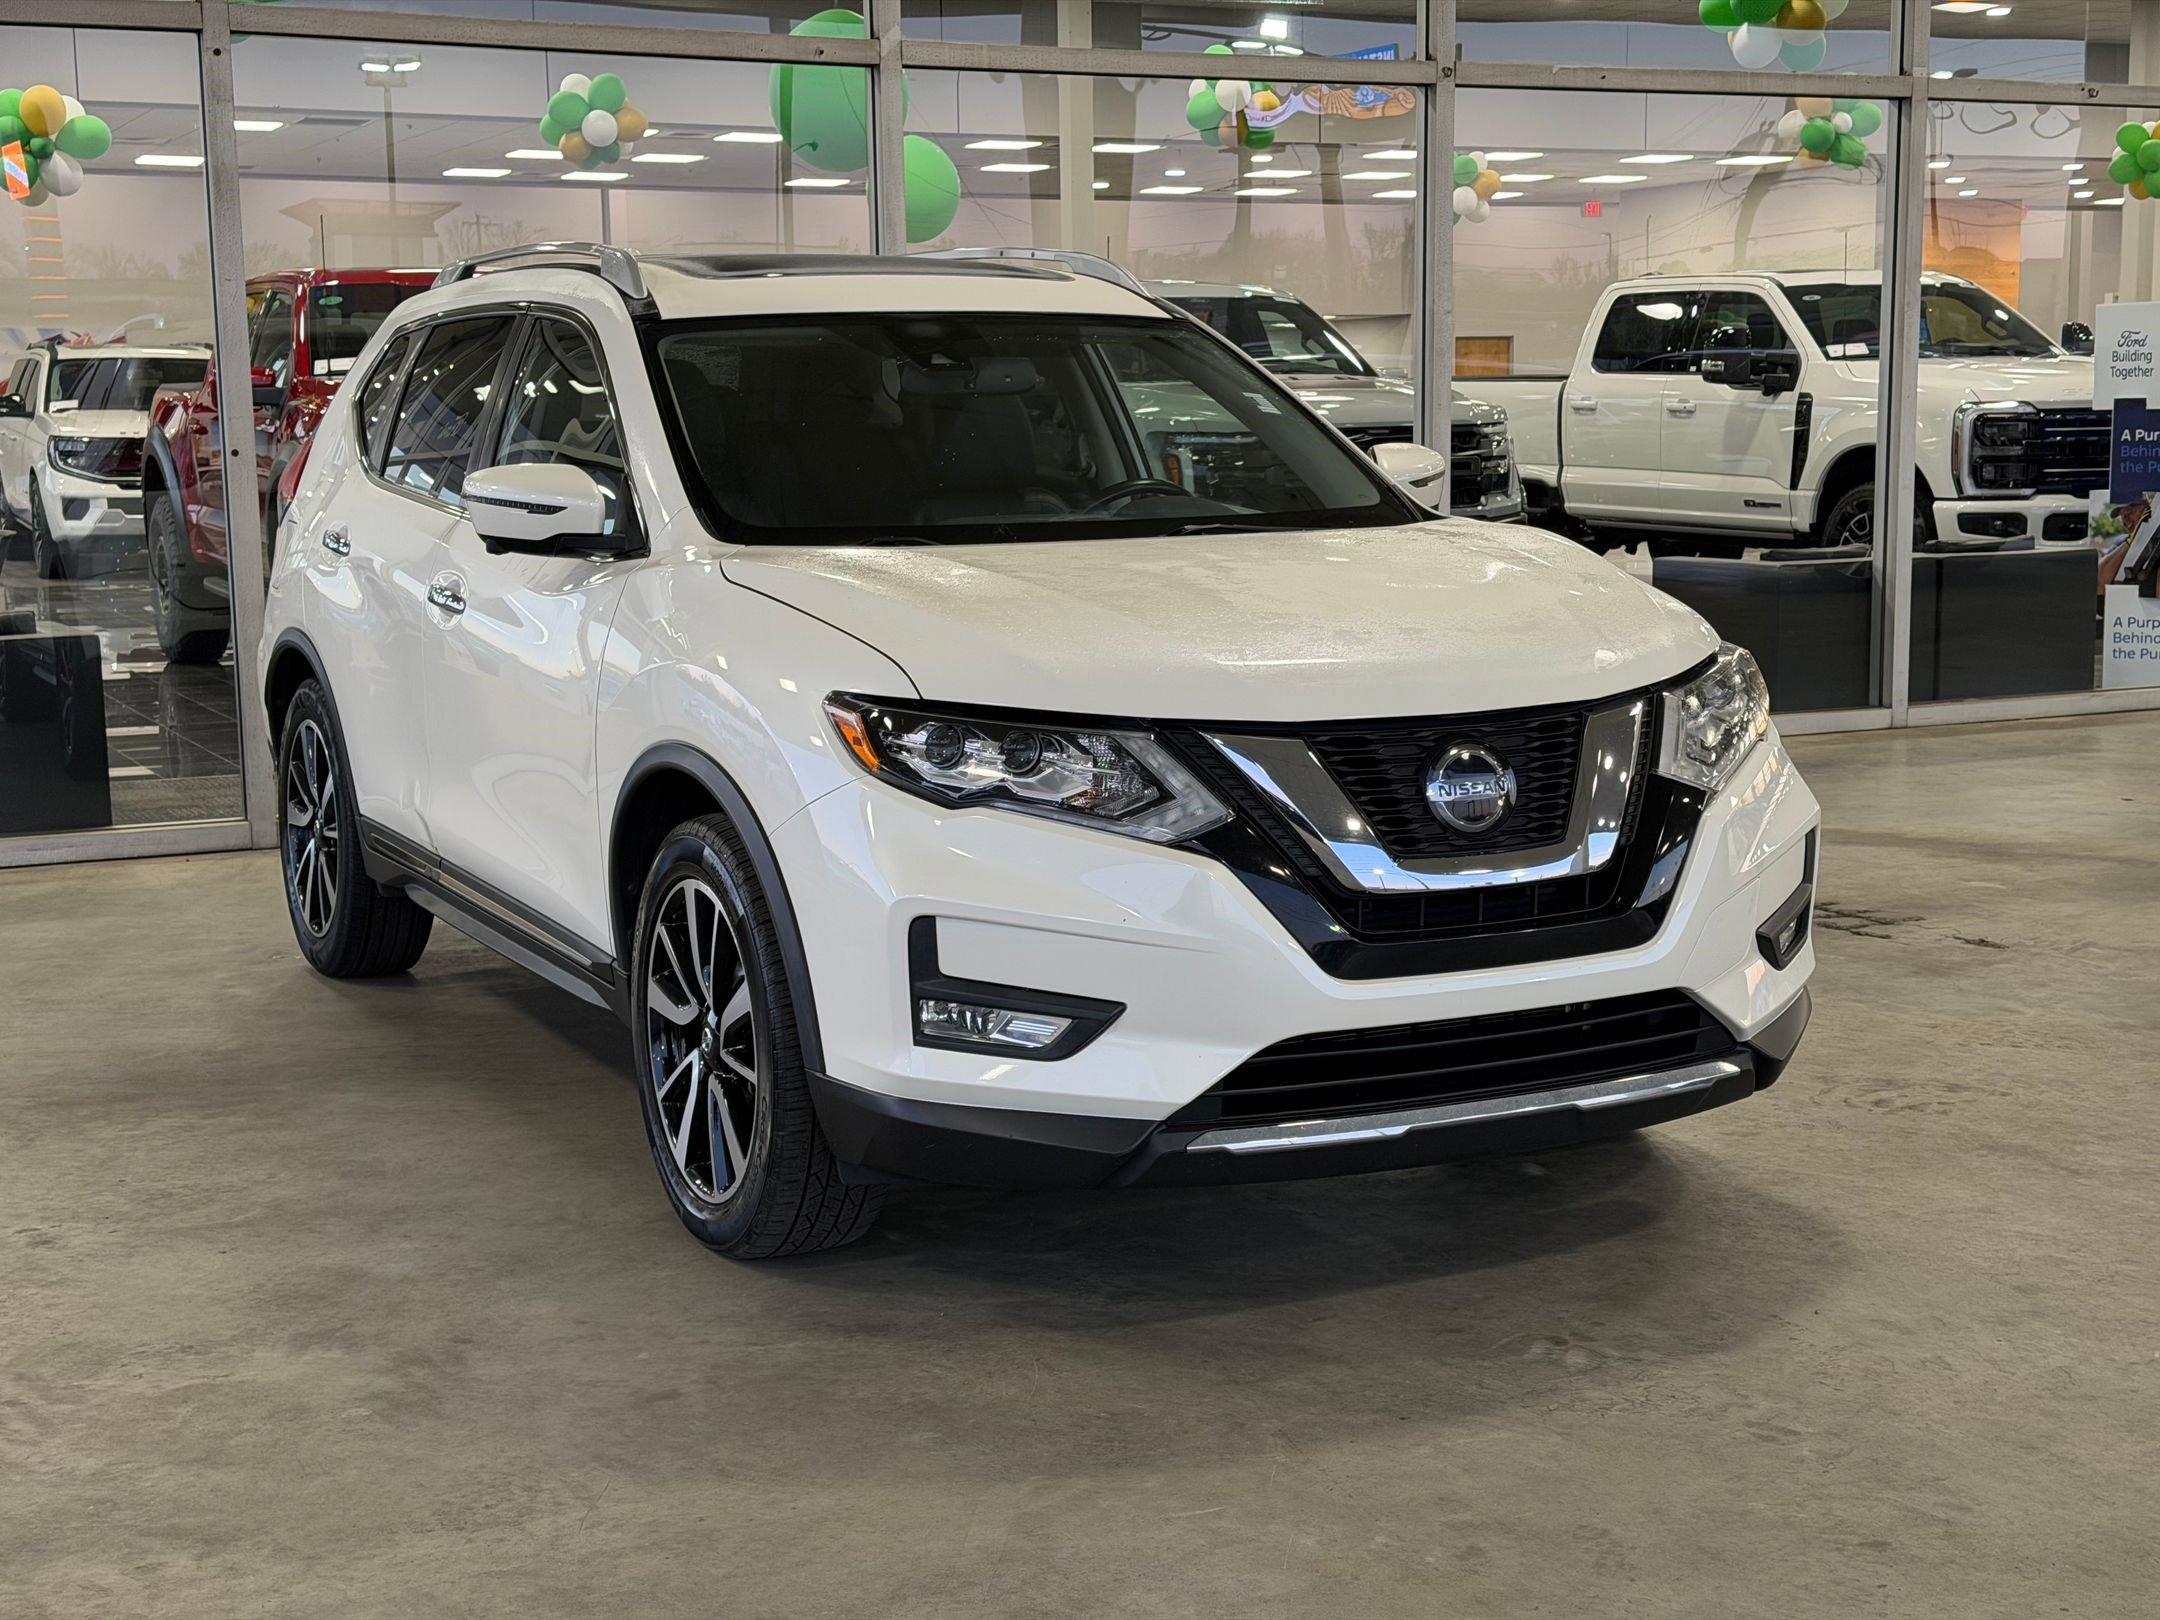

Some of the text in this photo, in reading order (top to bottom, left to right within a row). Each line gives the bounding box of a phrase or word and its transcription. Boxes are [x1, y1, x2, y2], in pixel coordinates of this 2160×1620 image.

[2117, 330, 2148, 348] Ford
[2111, 350, 2153, 364] Building
[2110, 366, 2154, 380] Together
[2120, 429, 2160, 441] A Pur
[2120, 461, 2144, 473] the
[2113, 616, 2160, 630] A Purp
[2112, 647, 2160, 660] the Pu
[1438, 780, 1506, 797] NISSAN
